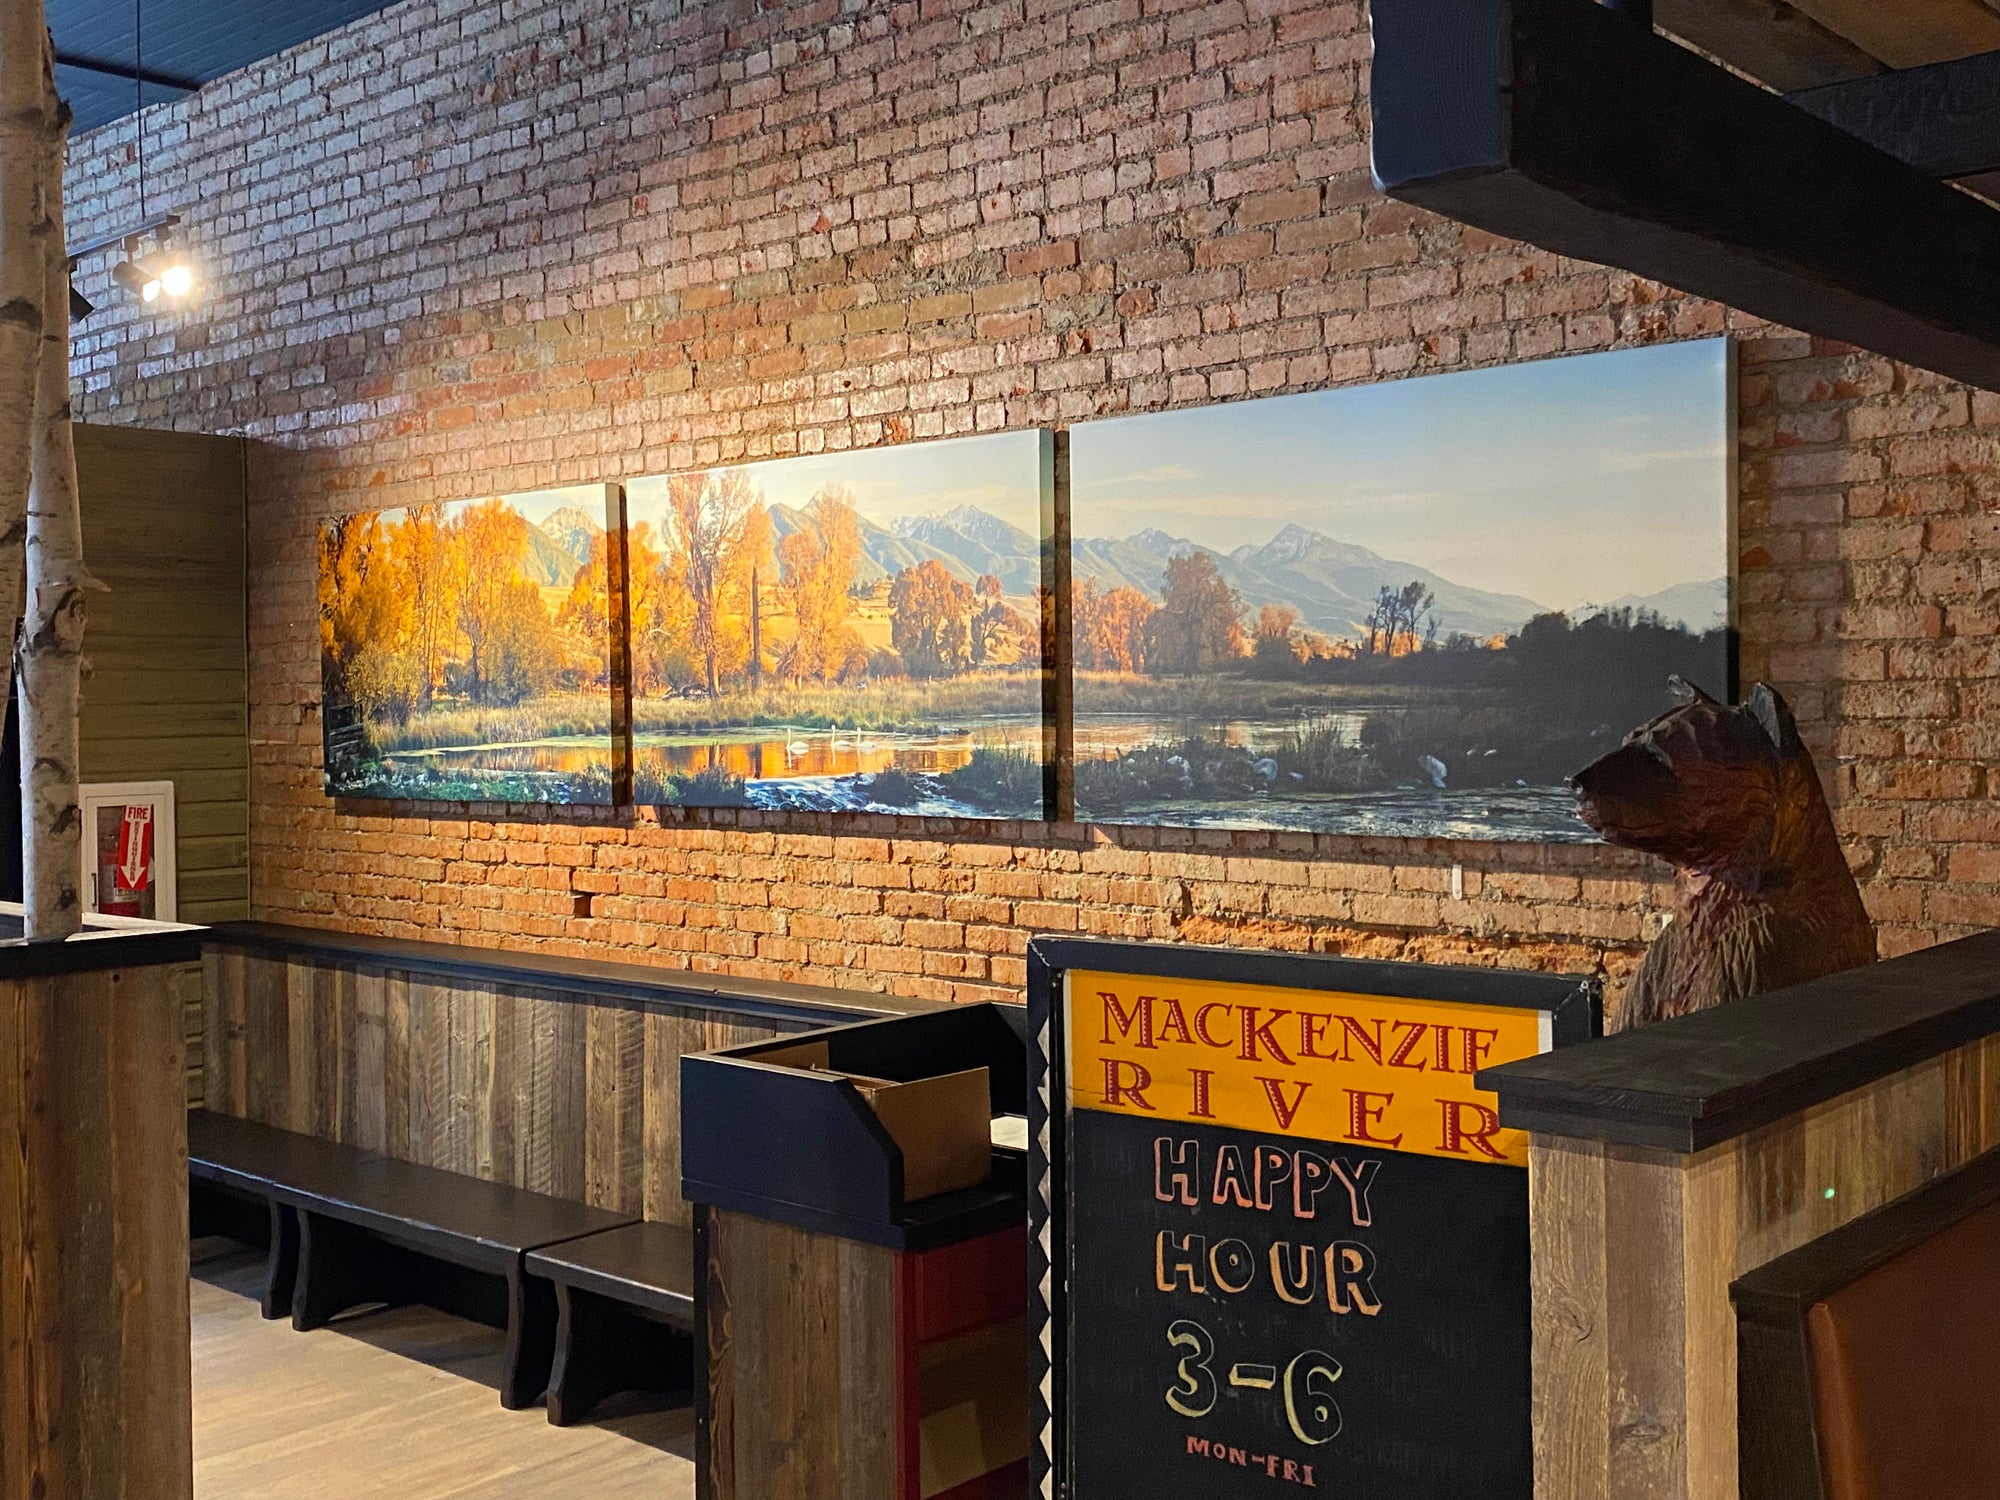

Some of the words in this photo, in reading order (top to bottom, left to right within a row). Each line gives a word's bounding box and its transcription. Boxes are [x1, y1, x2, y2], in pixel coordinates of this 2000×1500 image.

[128, 807, 149, 819] FIRE
[1098, 1058, 1509, 1159] RIVER
[1153, 1137, 1382, 1227] HAPPY
[1155, 1230, 1383, 1316] HOUR
[1165, 1319, 1343, 1445] 3-6
[1186, 1435, 1316, 1488] MON-FRI
